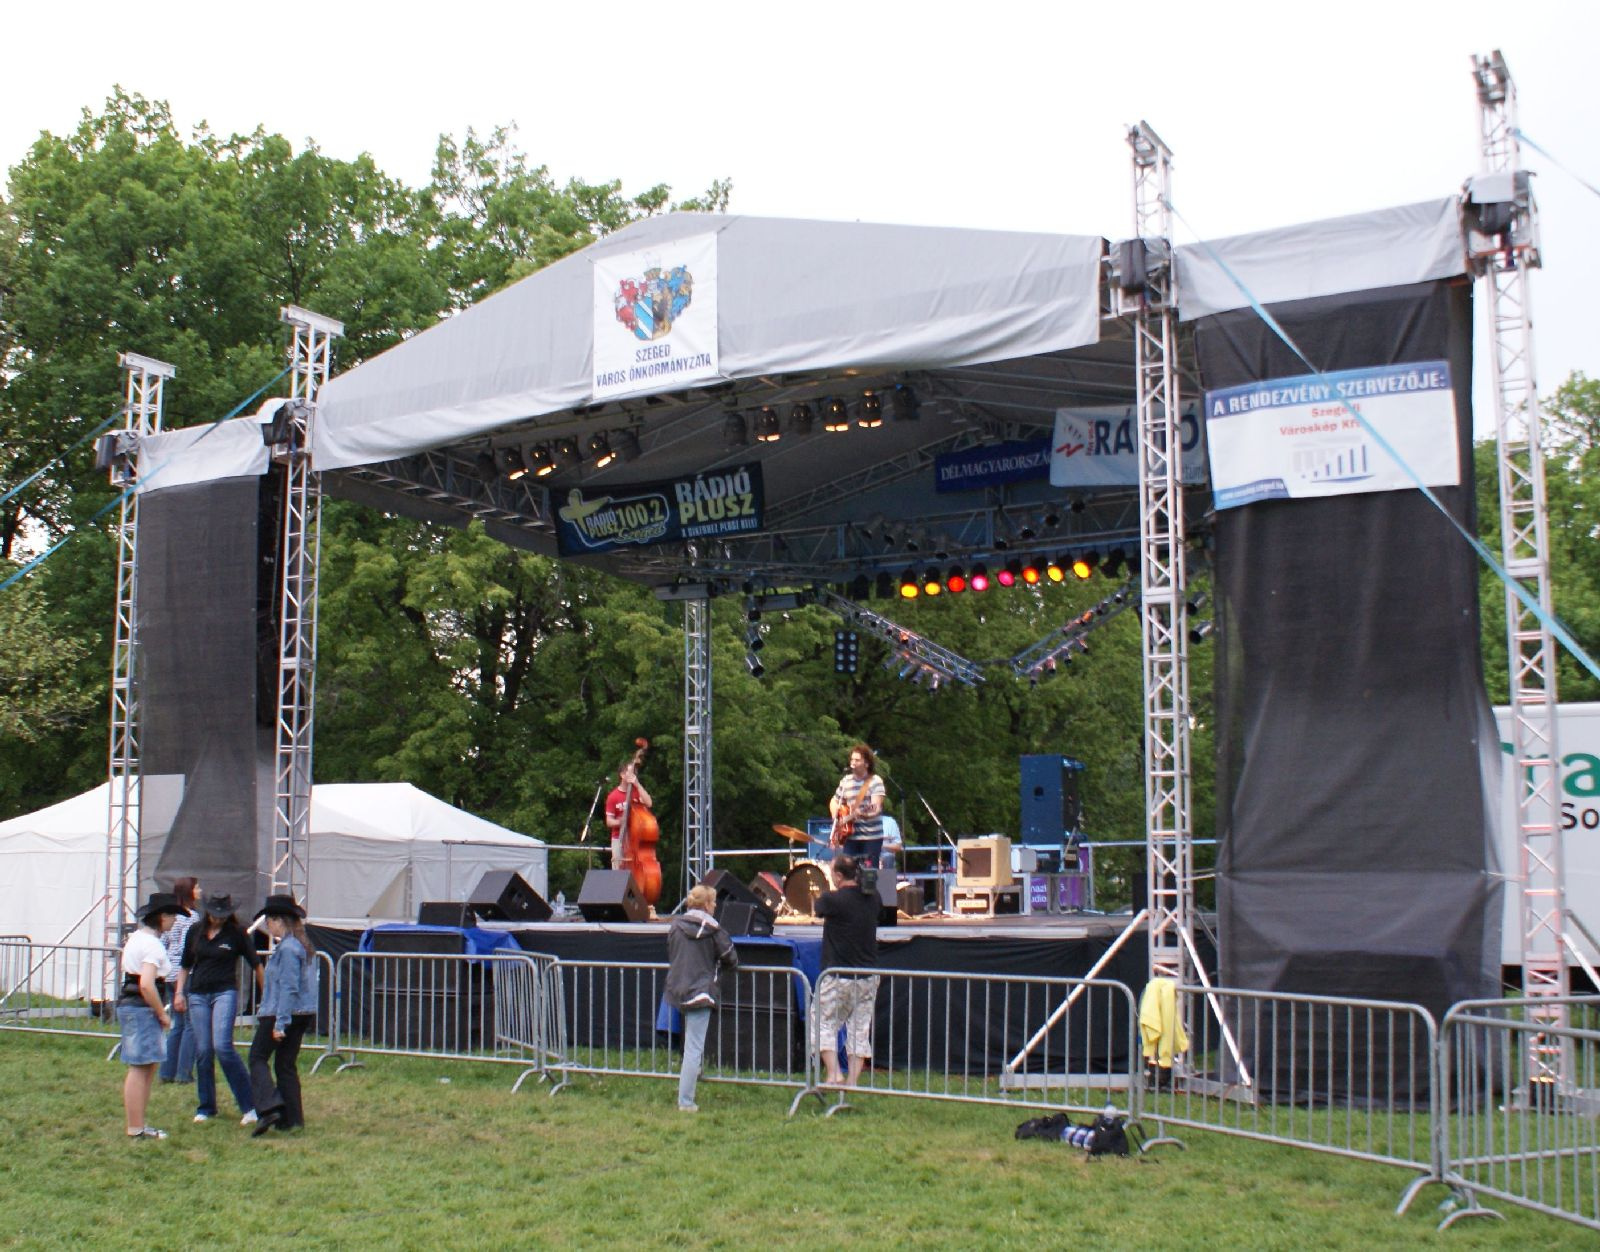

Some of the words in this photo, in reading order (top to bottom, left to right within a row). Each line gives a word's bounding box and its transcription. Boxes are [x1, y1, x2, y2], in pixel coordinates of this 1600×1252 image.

[635, 344, 671, 363] SZEGED
[1213, 402, 1225, 417] A
[1229, 384, 1330, 414] RENDEZVÉNY
[674, 466, 752, 503] RÁDIÓ
[616, 500, 665, 529] 100.2
[678, 493, 756, 525] PLUSZ
[588, 521, 619, 539] PLUSZ
